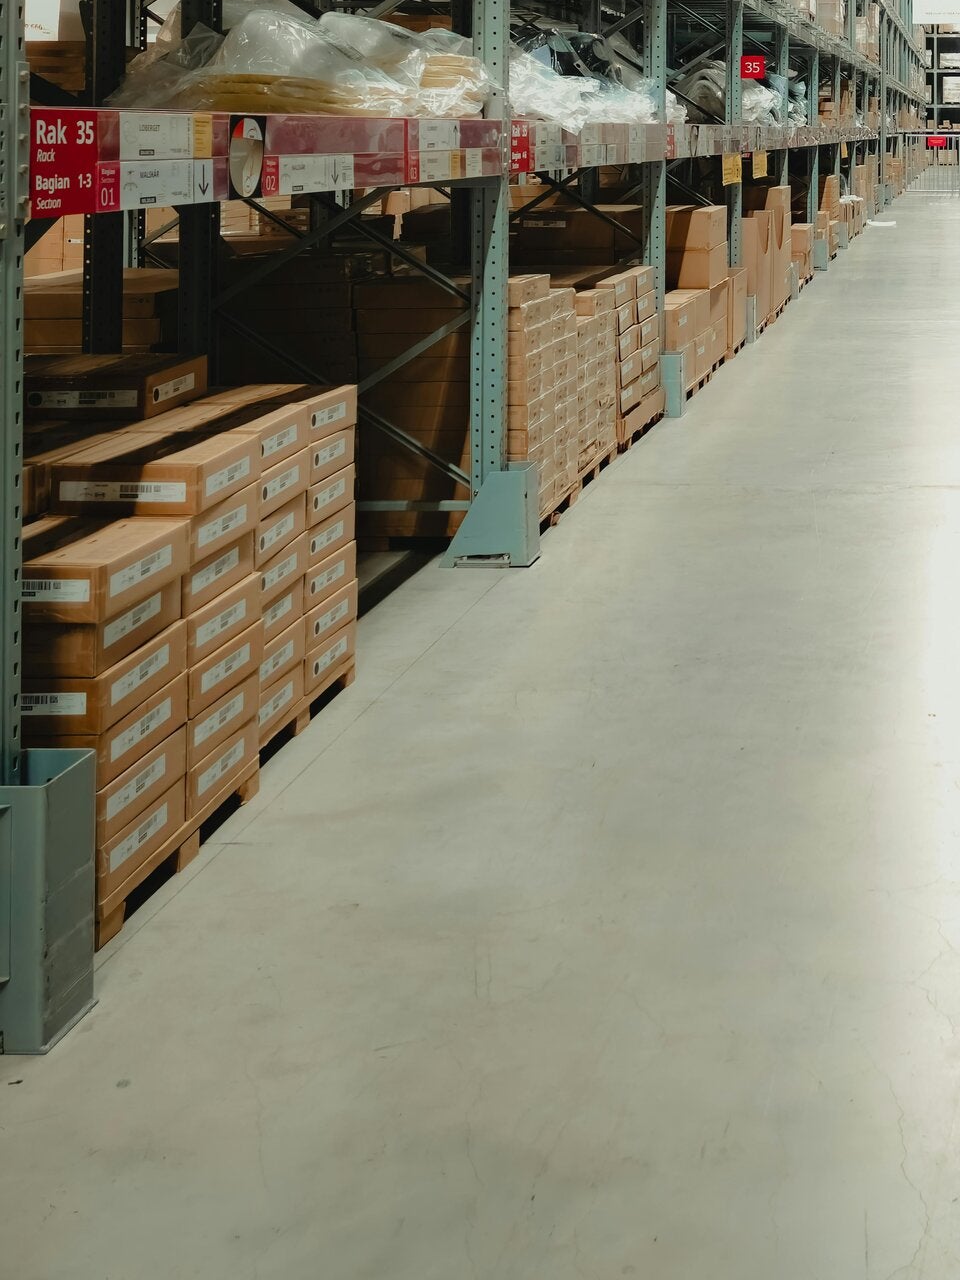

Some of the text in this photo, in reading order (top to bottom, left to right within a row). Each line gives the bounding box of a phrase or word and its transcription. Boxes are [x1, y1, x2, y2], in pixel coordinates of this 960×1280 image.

[745, 61, 760, 73] 35
[36, 119, 94, 144] Rak 35
[36, 148, 55, 162] Rack
[35, 173, 92, 194] Bagian 1-3
[265, 175, 276, 191] 02
[36, 197, 62, 210] Section
[101, 187, 115, 206] 01
